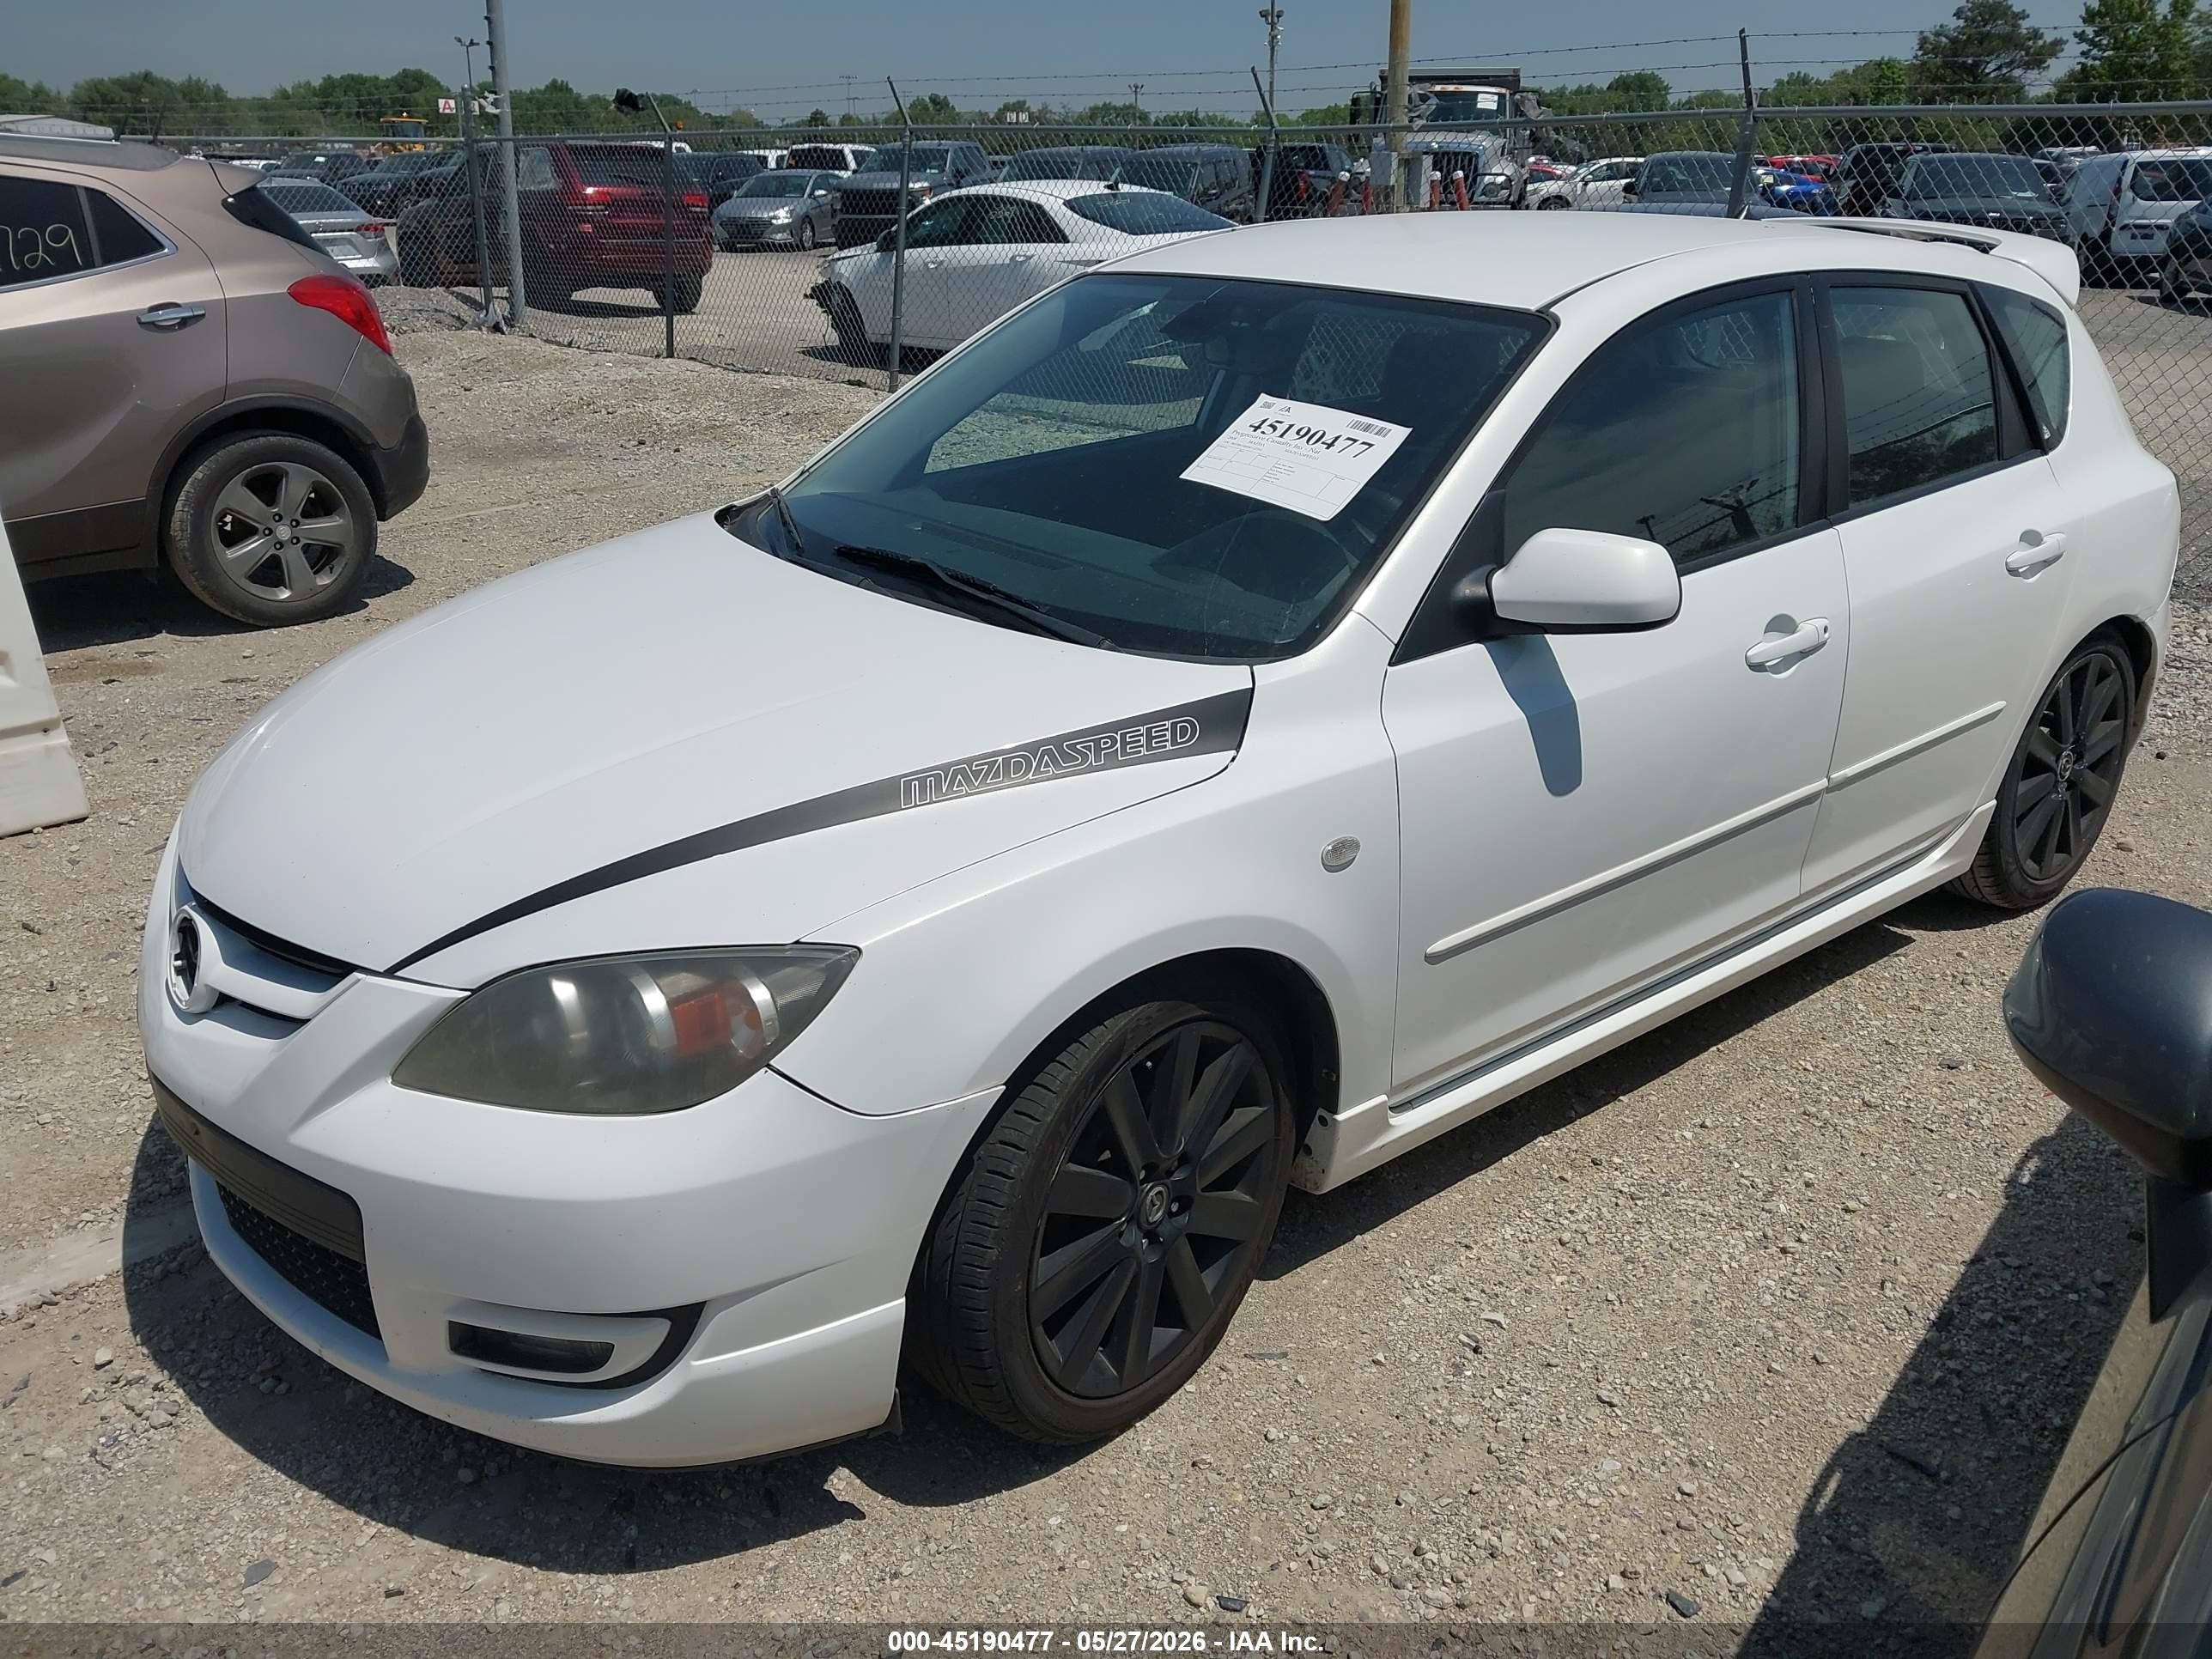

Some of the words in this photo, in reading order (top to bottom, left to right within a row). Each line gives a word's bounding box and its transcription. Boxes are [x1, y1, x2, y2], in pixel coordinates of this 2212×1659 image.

[442, 100, 453, 112] A
[1231, 429, 1267, 441] Progressive
[1267, 437, 1293, 448] Casualty
[1249, 417, 1376, 459] 45190477
[900, 716, 1200, 810] MAZDASPEED
